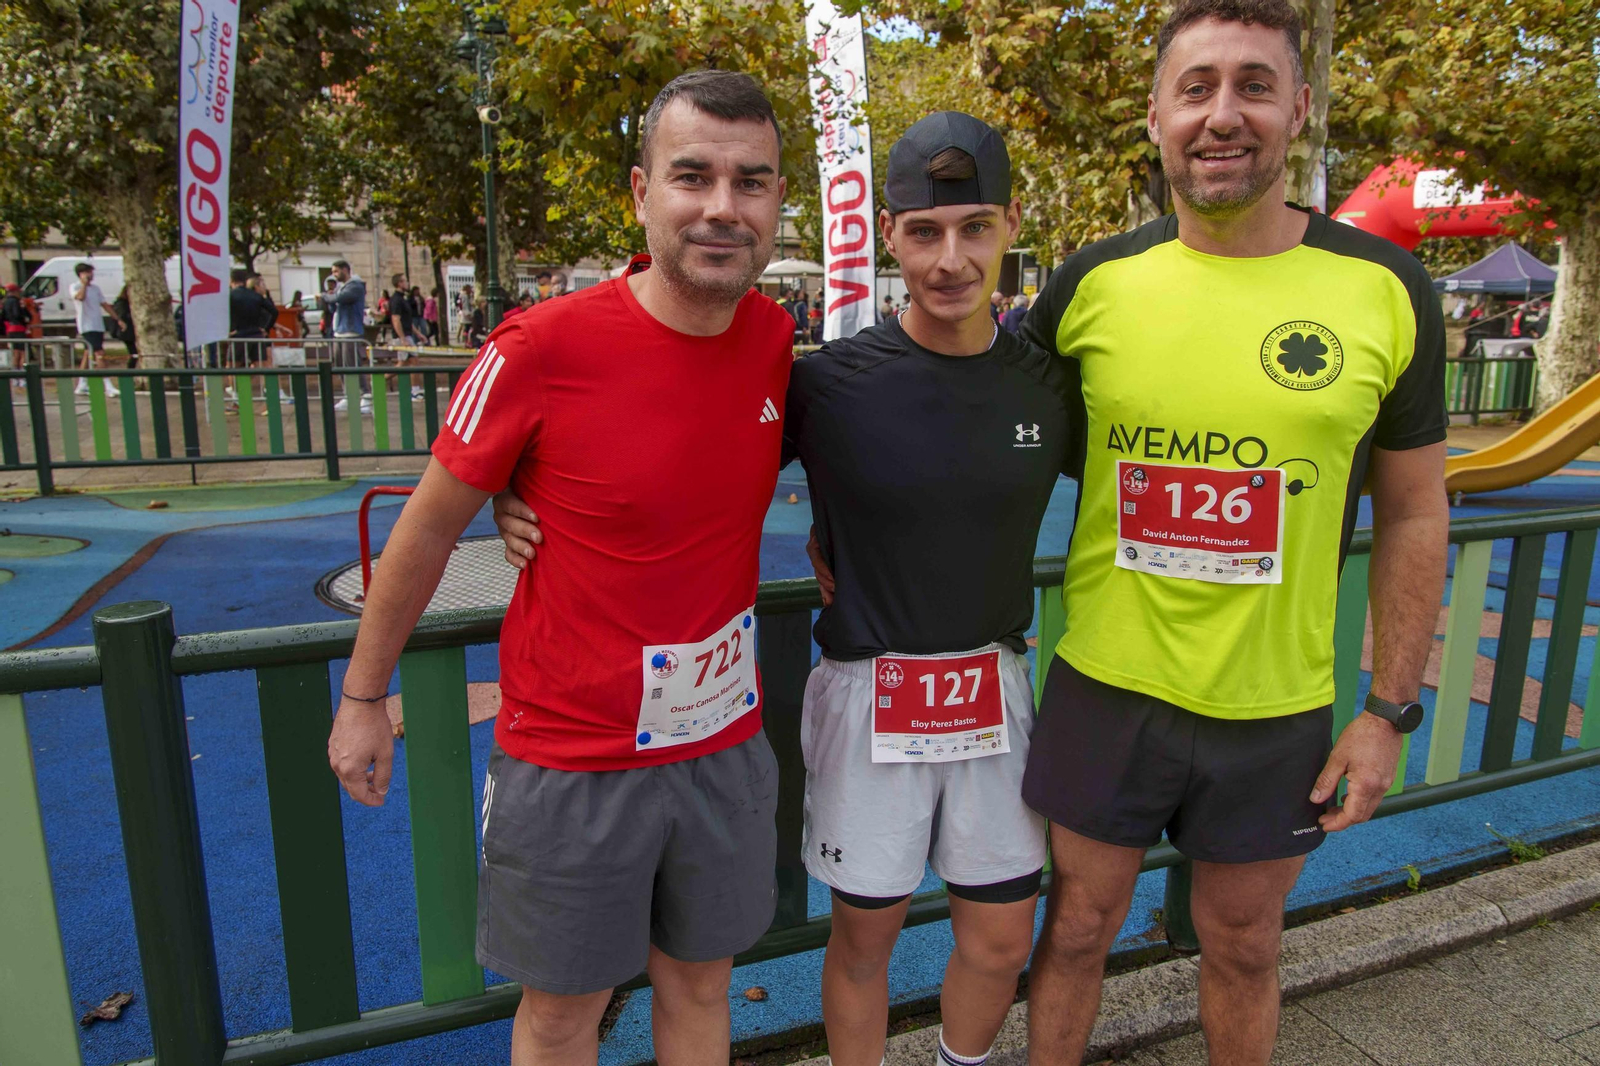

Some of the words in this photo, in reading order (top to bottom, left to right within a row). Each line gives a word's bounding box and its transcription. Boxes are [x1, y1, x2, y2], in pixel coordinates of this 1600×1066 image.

[208, 11, 220, 70] mellor
[204, 72, 214, 102] teu
[212, 22, 232, 124] deporte
[204, 106, 211, 118] o
[186, 128, 222, 304] VIGO
[827, 170, 869, 316] VIGO
[1276, 323, 1312, 335] CARREIRA
[1316, 326, 1340, 358] SOLIDARIA
[1280, 378, 1294, 387] POLA
[1296, 380, 1326, 389] ESCLEROSE
[1106, 422, 1268, 468] AVEMPO
[1164, 482, 1252, 524] 126
[1142, 528, 1168, 540] David
[1169, 532, 1198, 542] Anton
[1200, 535, 1250, 547] Fernandez
[694, 628, 742, 688] 722
[886, 671, 898, 682] 14
[670, 704, 694, 714] Oscar
[696, 692, 720, 708] Canosa
[720, 676, 741, 696] Martinez
[918, 668, 982, 706] 127
[911, 720, 930, 729] Eloy
[930, 720, 952, 728] Perez
[954, 716, 977, 726] Bastos
[1292, 826, 1318, 836] KIPRUN
